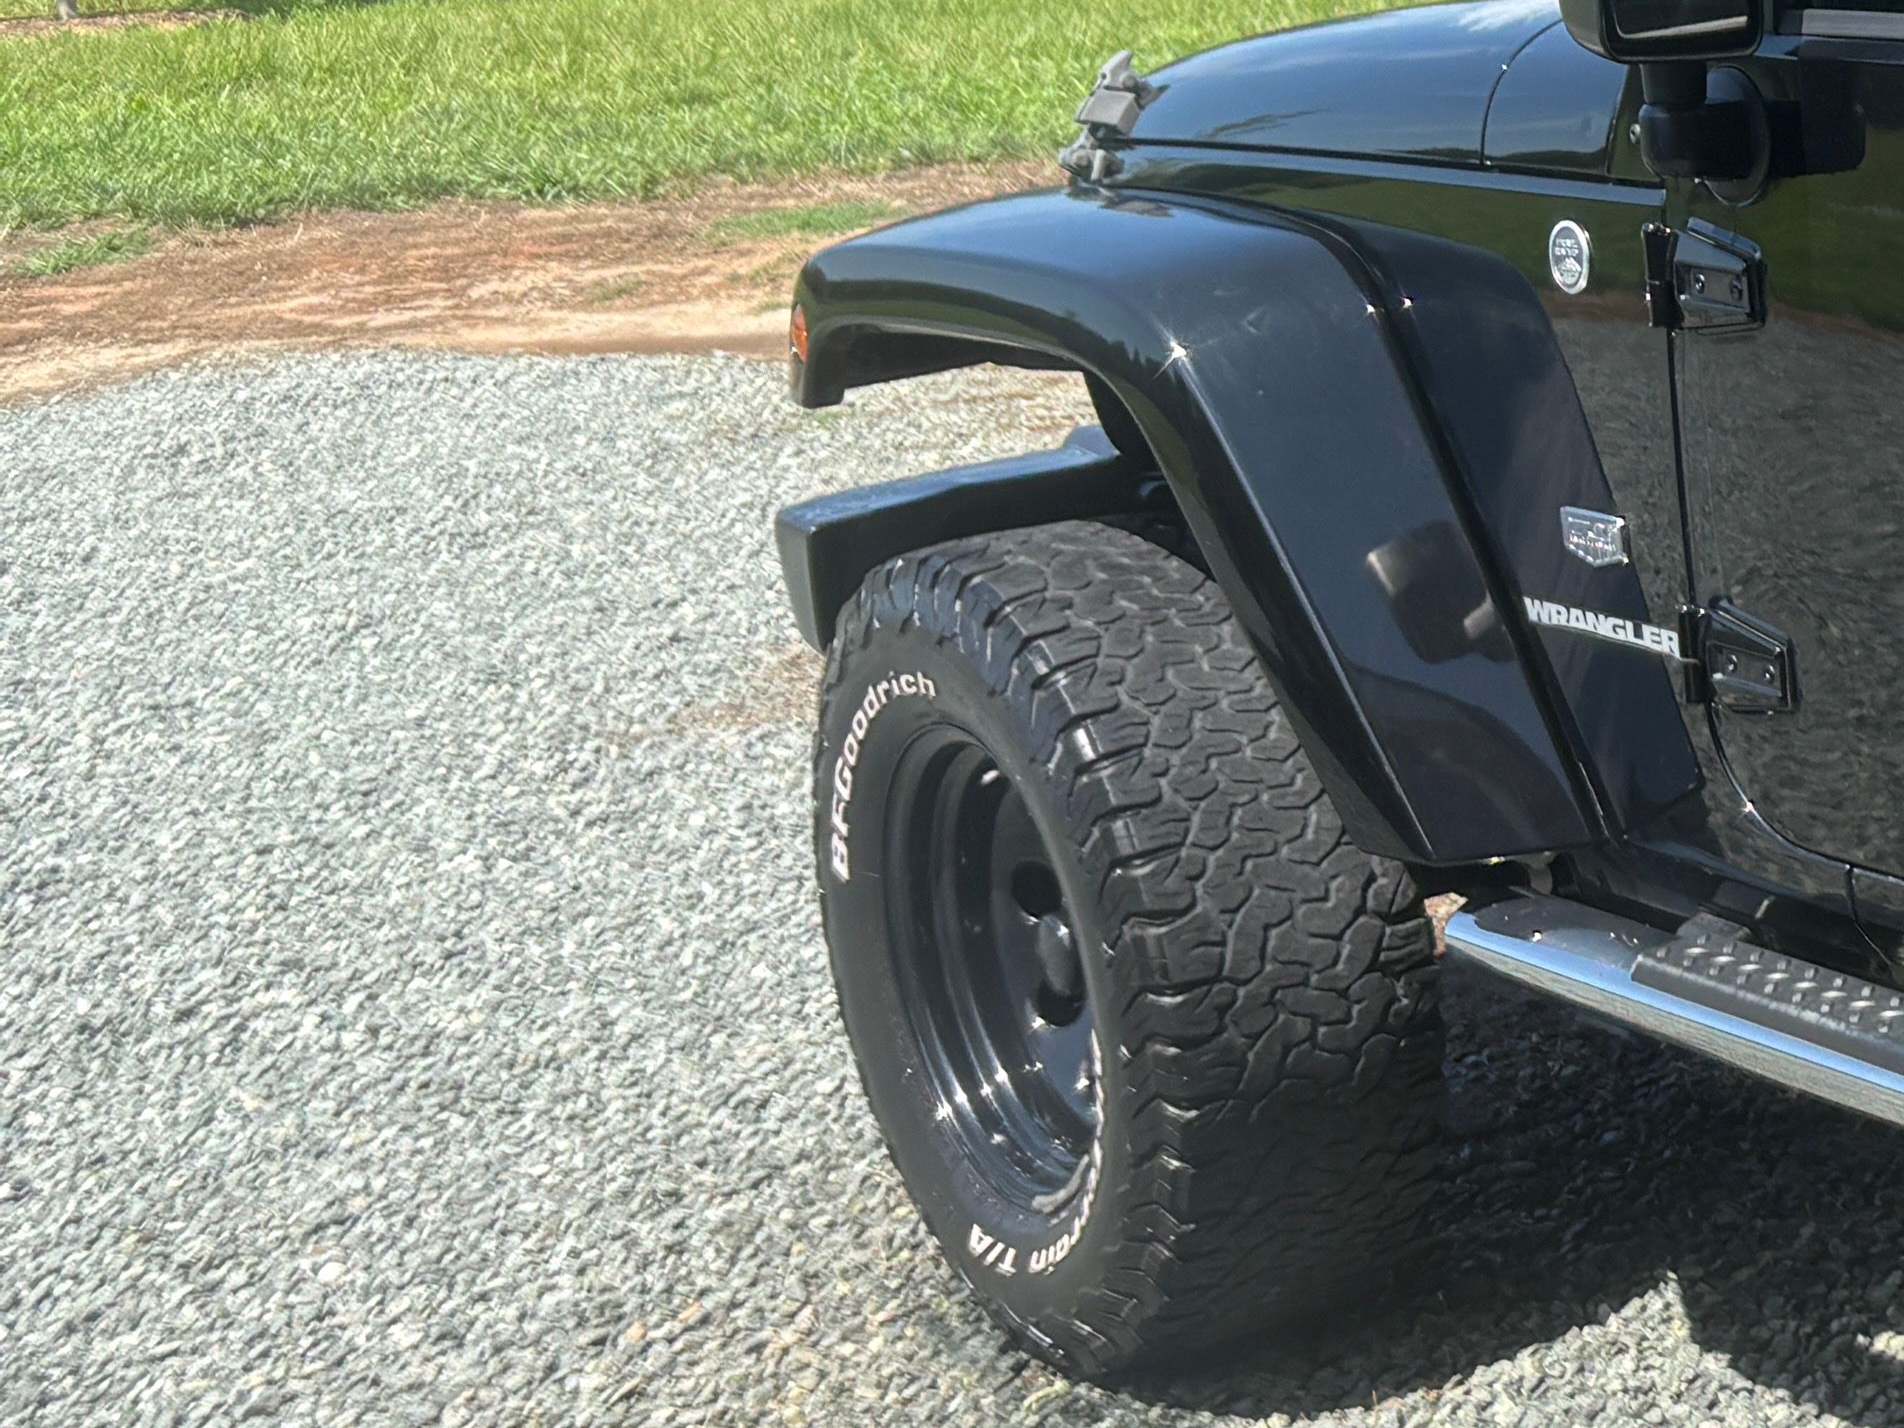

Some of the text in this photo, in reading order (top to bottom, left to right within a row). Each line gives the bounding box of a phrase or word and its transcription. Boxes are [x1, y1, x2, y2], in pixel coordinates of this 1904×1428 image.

[1523, 596, 1681, 659] WRANGLER
[831, 670, 936, 882] BFGoodrich
[968, 1223, 1017, 1276] T/A
